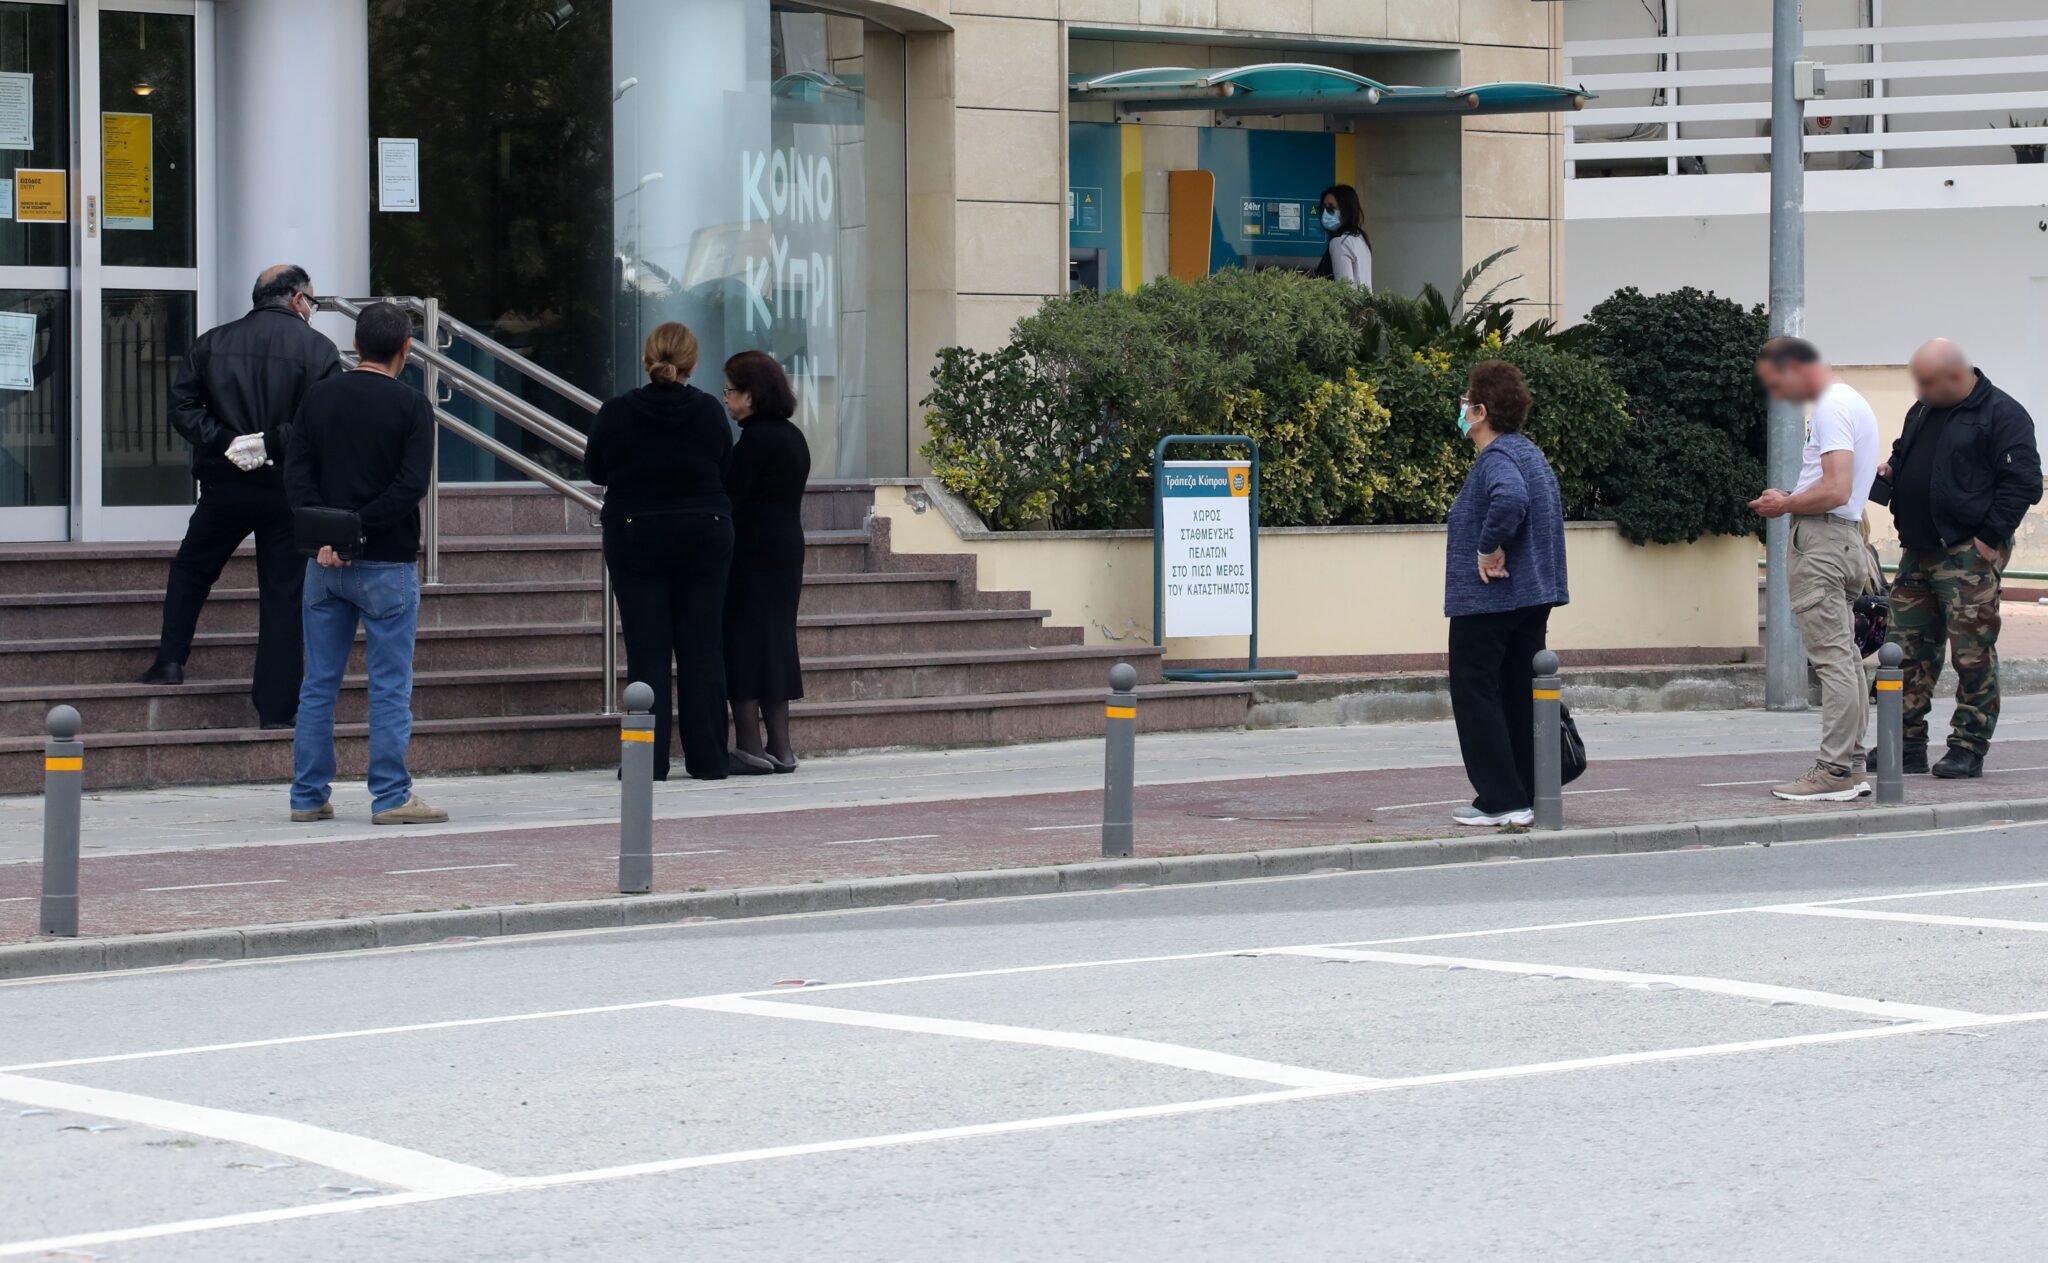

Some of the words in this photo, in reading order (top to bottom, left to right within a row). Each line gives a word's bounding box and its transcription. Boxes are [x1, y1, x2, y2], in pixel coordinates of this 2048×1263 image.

[742, 147, 834, 232] ΚΟΙΝΟ
[1243, 202, 1261, 211] 24hr
[745, 232, 833, 332] ΚΥΠΡΙ
[1165, 475, 1196, 490] Τράπεζα
[1198, 474, 1228, 490] Κύπρου
[1193, 509, 1221, 522] ΧΩΡΟΣ
[1181, 528, 1234, 540] ΣΤΑΘΜΕΥΣΗΣ
[1188, 546, 1227, 559] ΠΕΛΑΤΩΝ
[1172, 565, 1188, 578] ΣΤΟ
[1191, 564, 1212, 577] ΠΙΣΩ
[1216, 564, 1245, 577] ΜΕΡΟΣ
[1168, 583, 1183, 597] ΤΟΥ
[1187, 582, 1250, 596] ΚΑΤΑΣΤΗΜΑΤΟΣ
